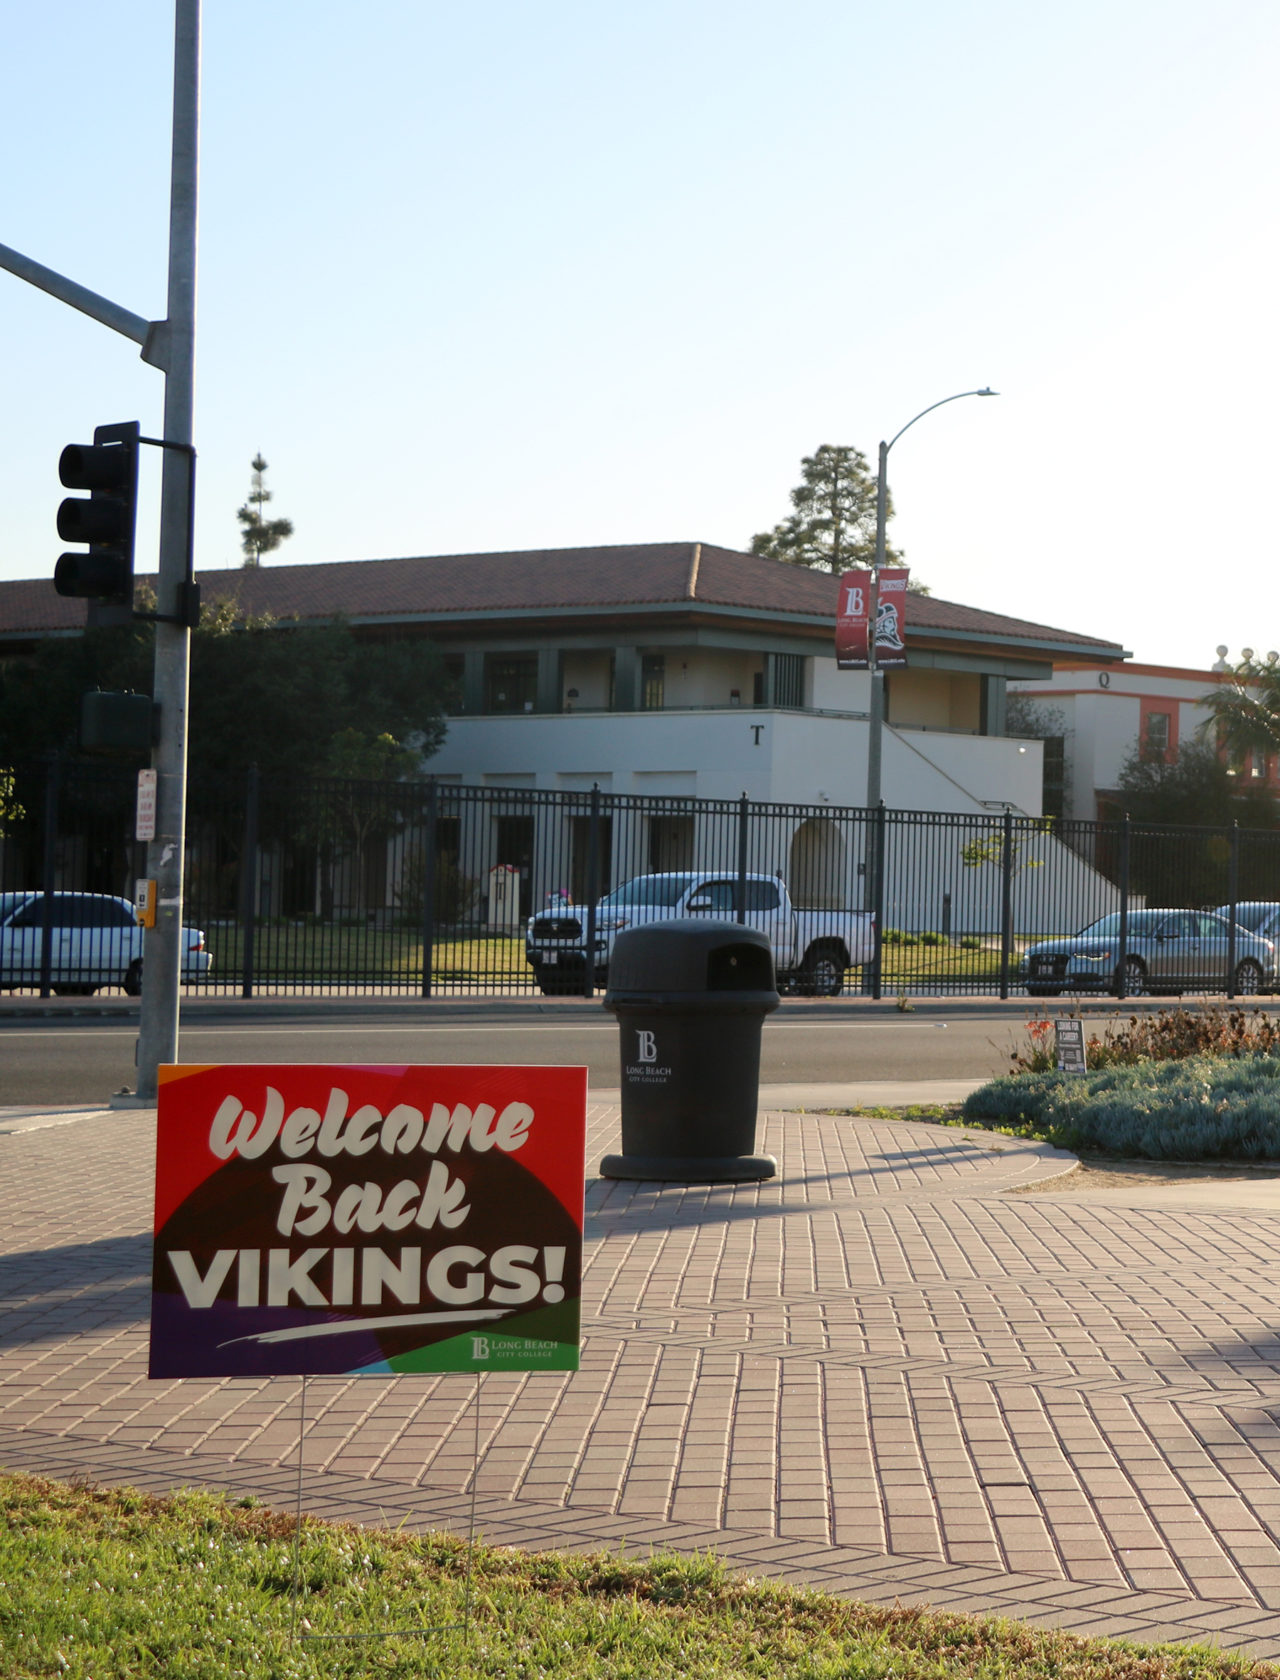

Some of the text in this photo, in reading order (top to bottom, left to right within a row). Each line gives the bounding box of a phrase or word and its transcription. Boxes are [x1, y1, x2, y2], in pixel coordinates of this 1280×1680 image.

[1099, 671, 1110, 689] Q
[750, 724, 765, 746] T
[626, 1065, 672, 1076] LONG BEACH
[209, 1086, 535, 1160] Welcome
[272, 1160, 472, 1236] Back
[167, 1245, 567, 1309] VIKINGS!
[492, 1340, 558, 1350] LONG BEACH
